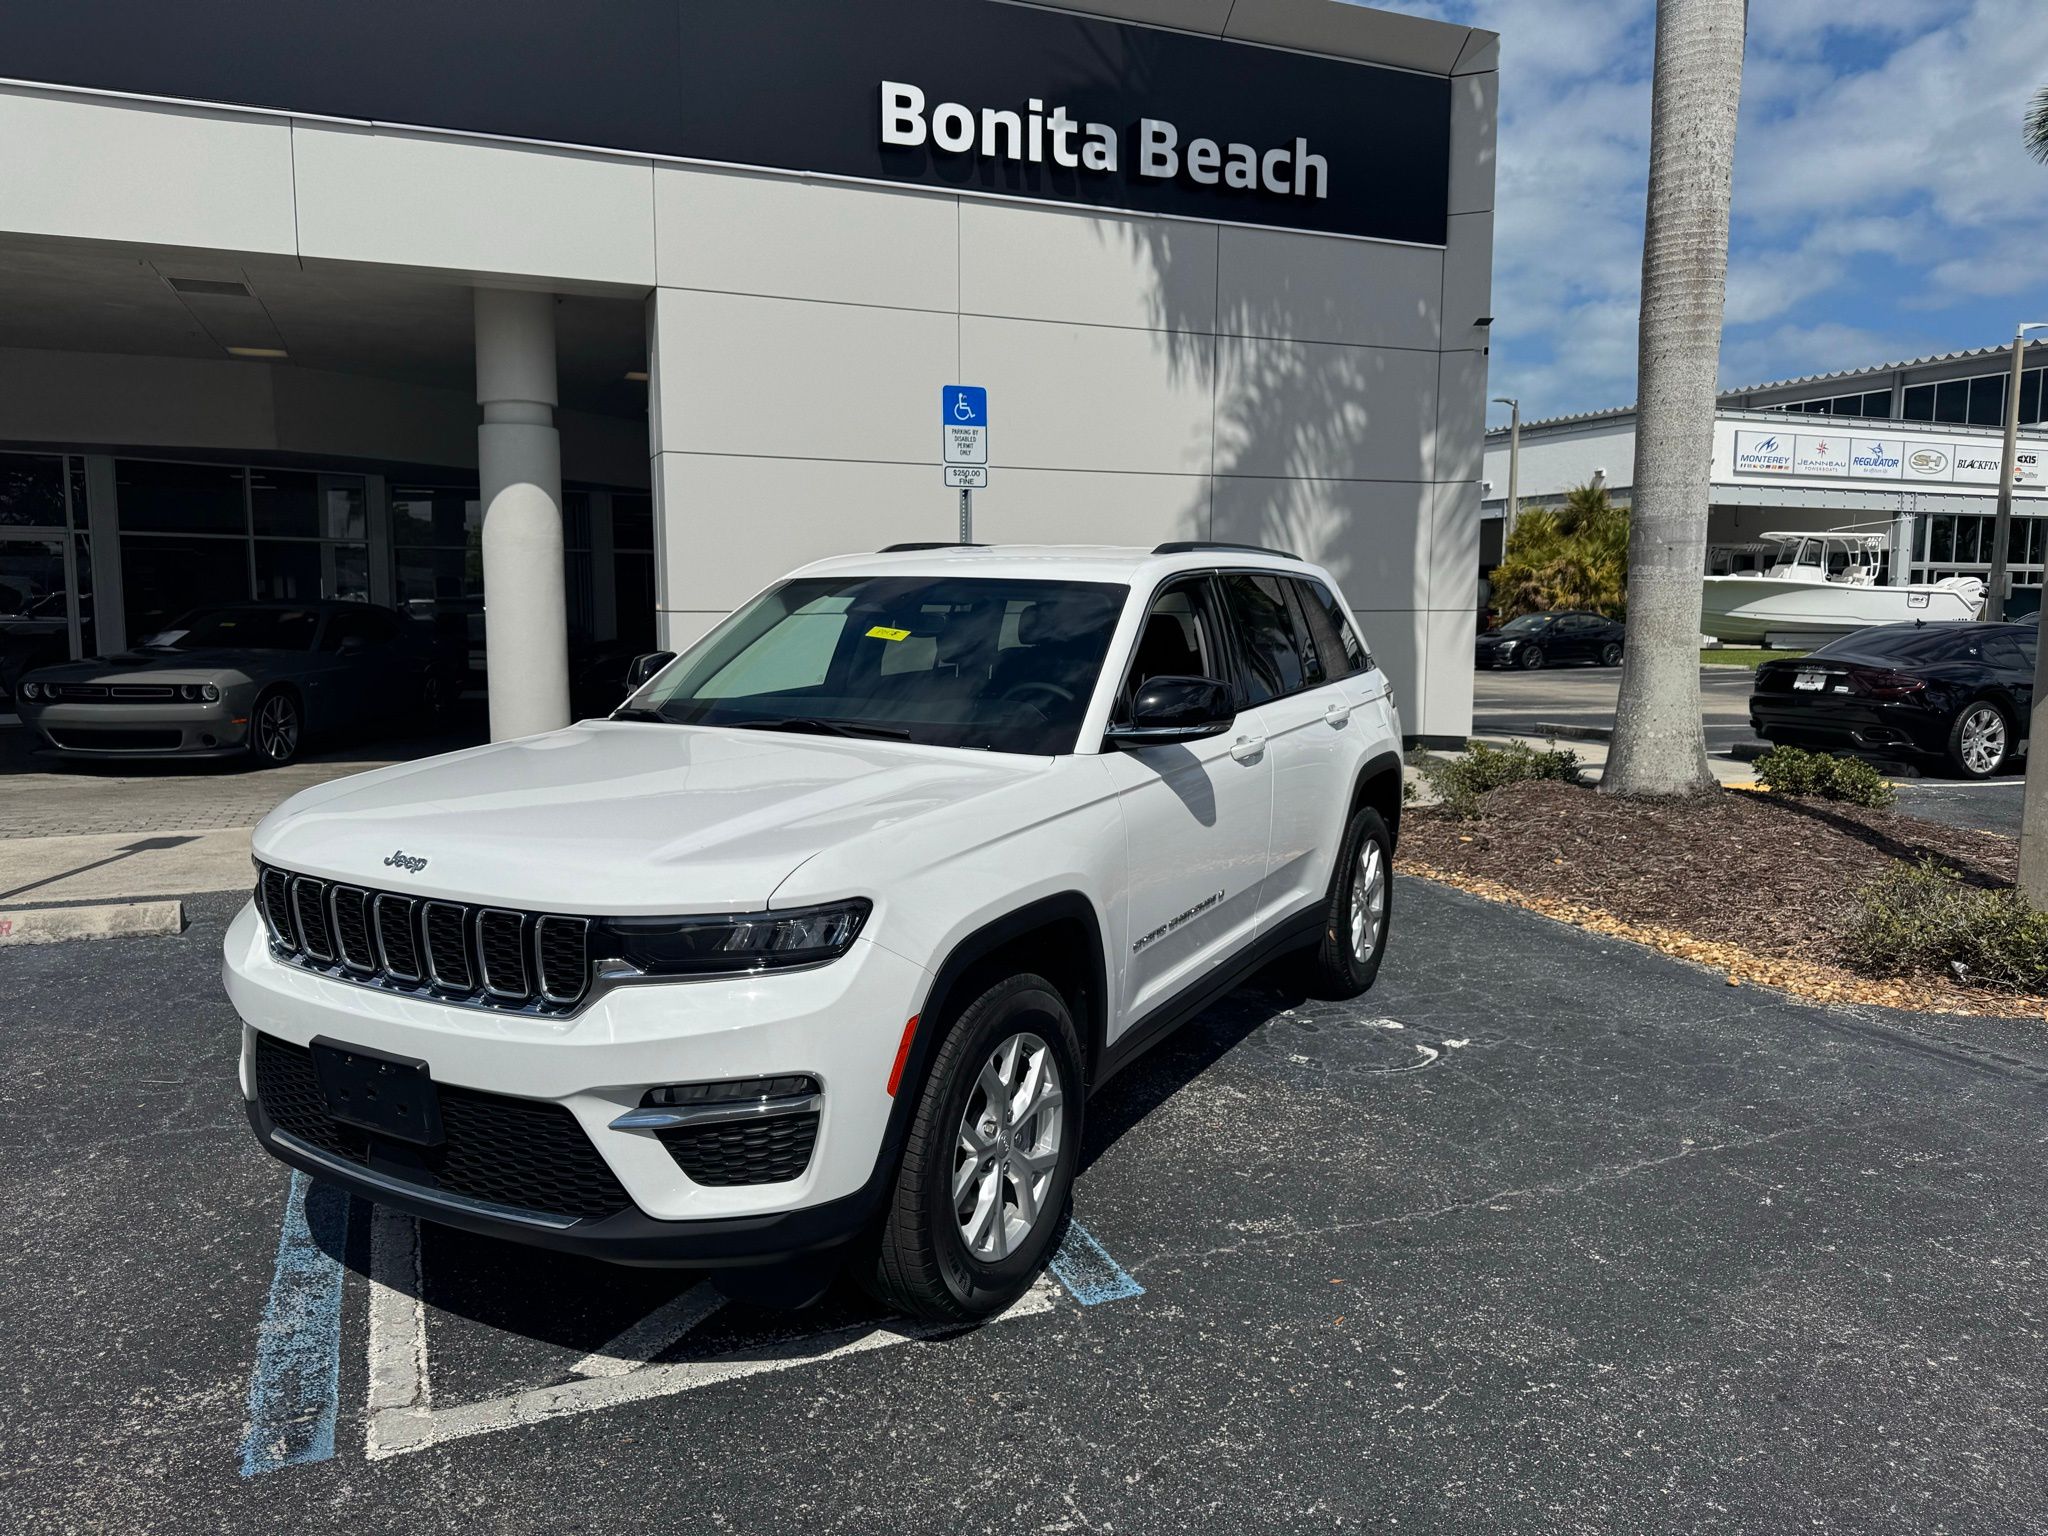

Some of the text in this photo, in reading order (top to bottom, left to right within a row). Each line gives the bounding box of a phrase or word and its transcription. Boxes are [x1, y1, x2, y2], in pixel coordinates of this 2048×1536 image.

[881, 80, 1328, 199] Bonita Beach
[951, 428, 971, 436] PARKING
[1740, 454, 1790, 465] MONTEREY
[1797, 459, 1847, 467] JEANNEAU
[1852, 456, 1900, 468] REGULATOR
[1957, 459, 2001, 471] BLACKFIN
[2017, 455, 2037, 464] AXIS
[953, 469, 981, 477] $250.00
[383, 850, 428, 874] Jeep
